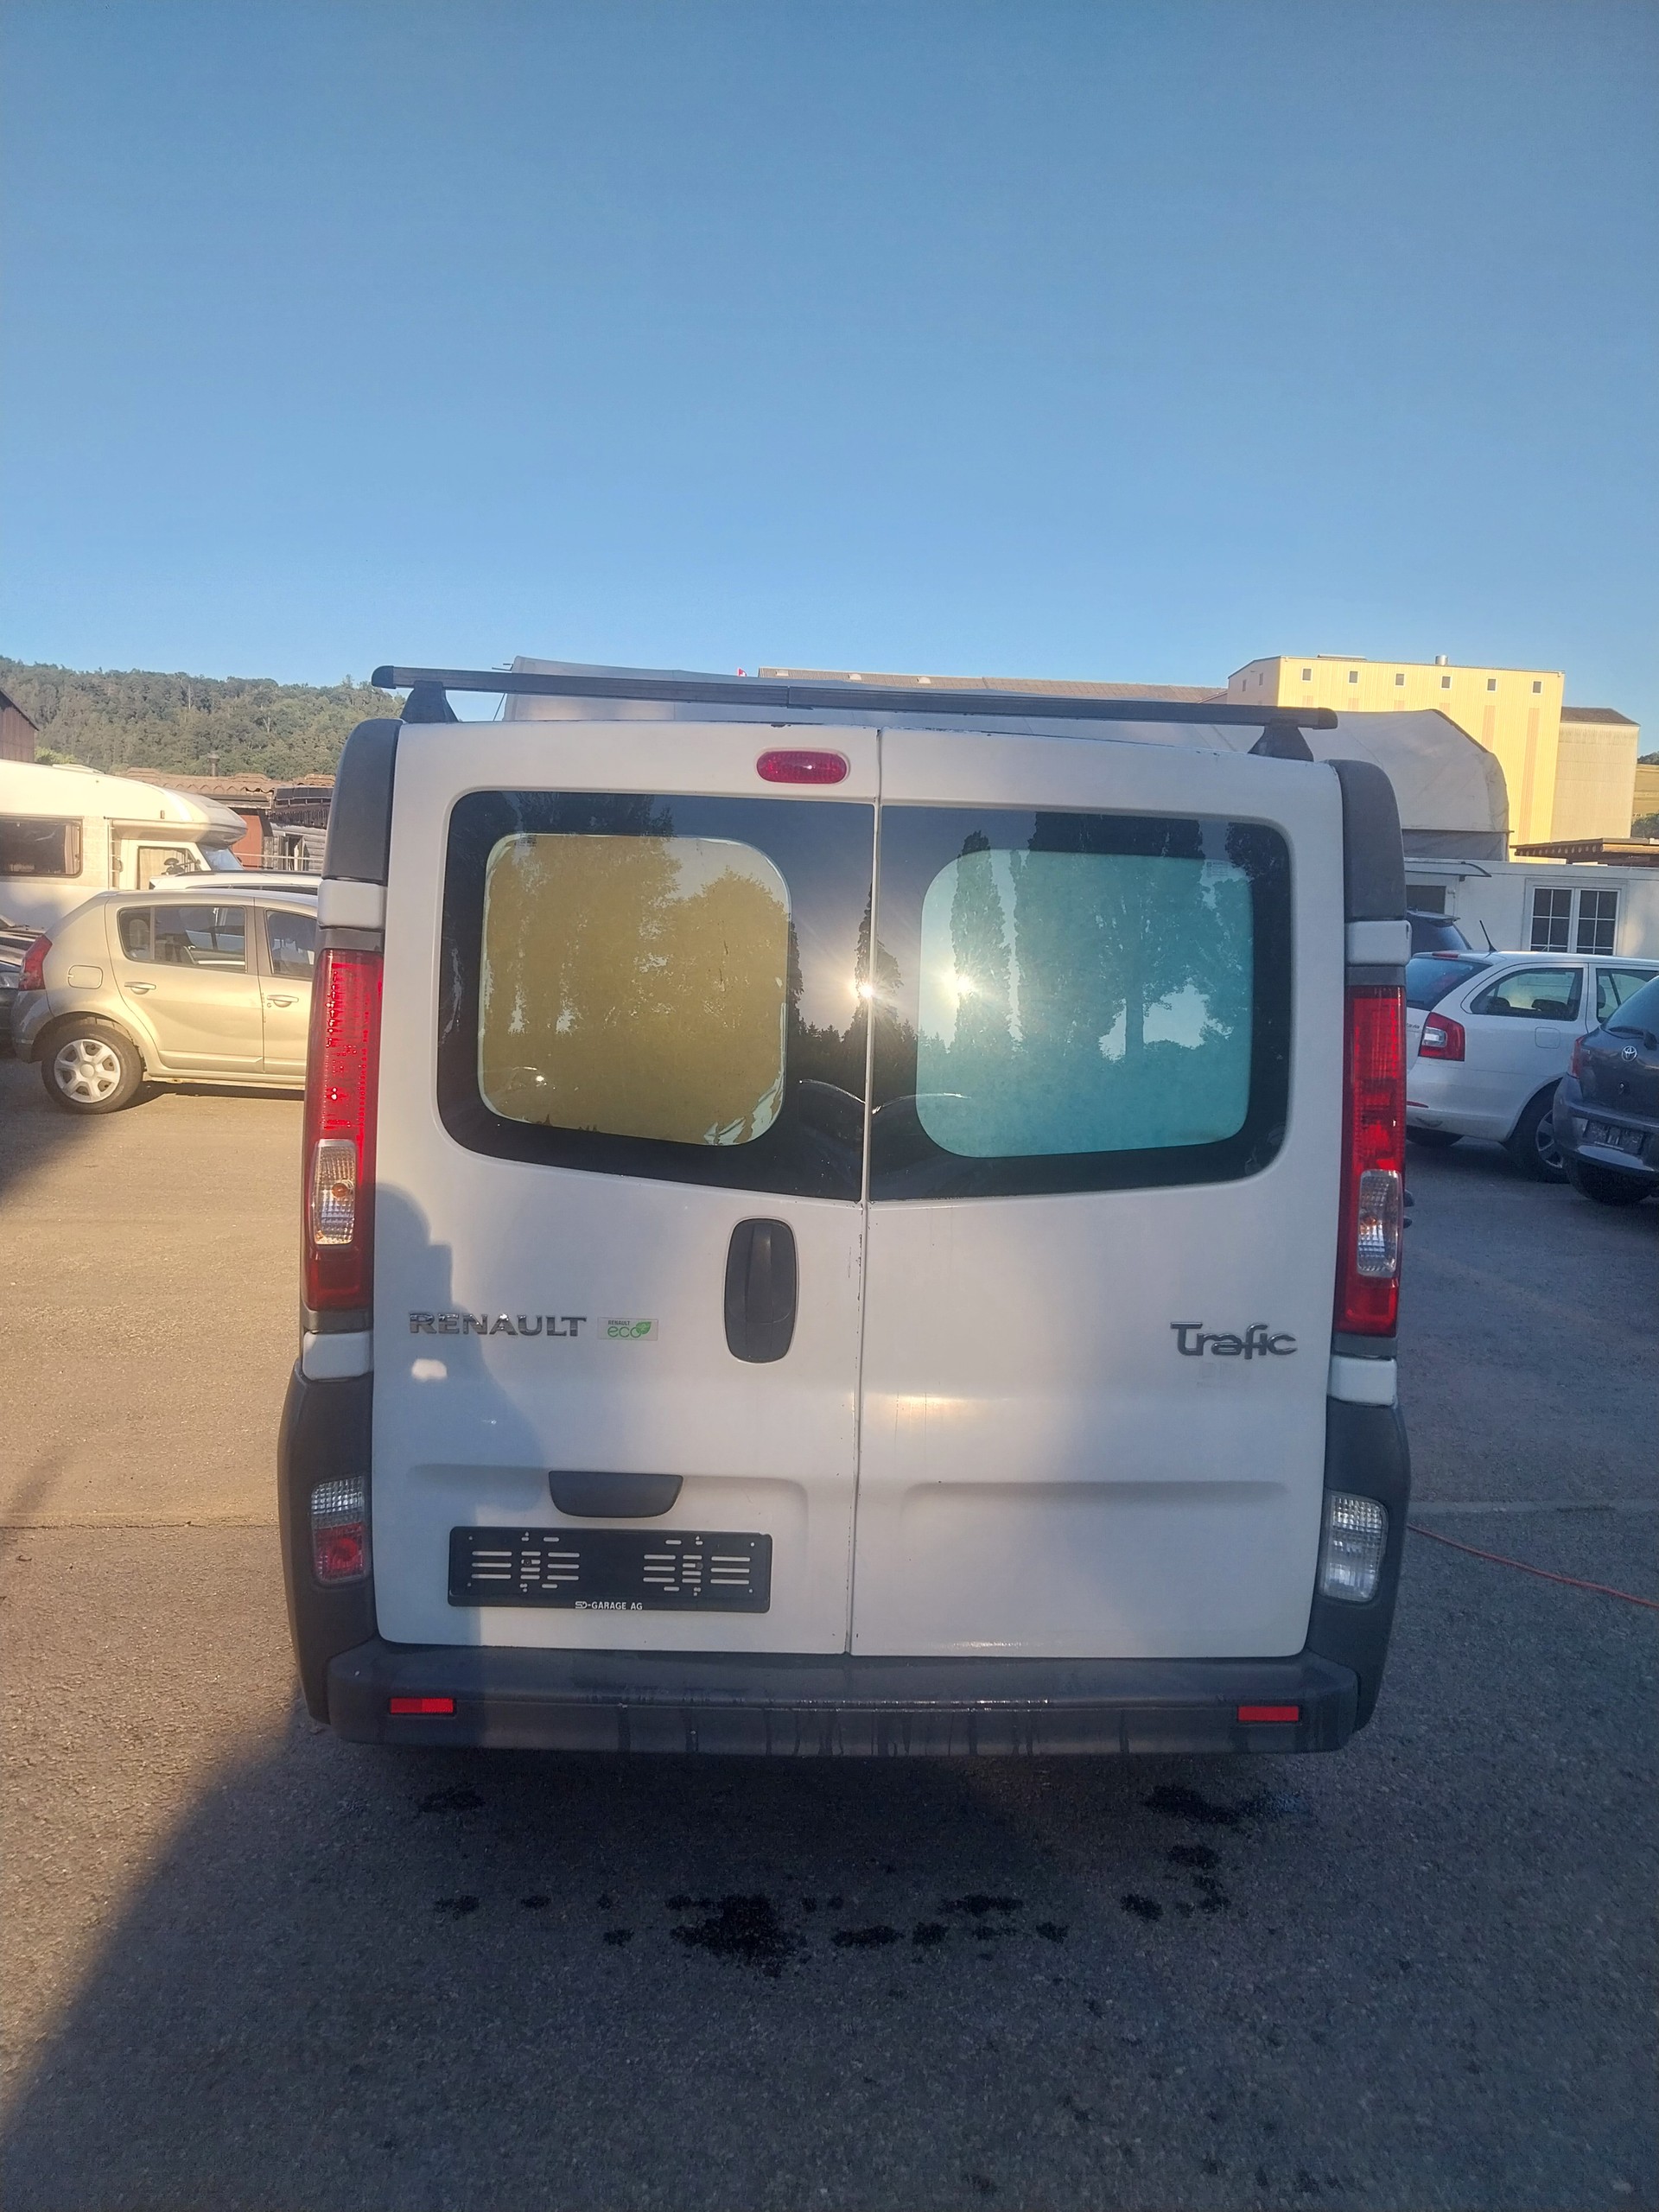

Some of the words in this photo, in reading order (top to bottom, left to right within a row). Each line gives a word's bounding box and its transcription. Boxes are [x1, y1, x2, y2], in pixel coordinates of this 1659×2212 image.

[409, 1313, 587, 1337] RENAULT
[1170, 1322, 1298, 1360] Trafic
[575, 1600, 626, 1610] SD-GARAGE
